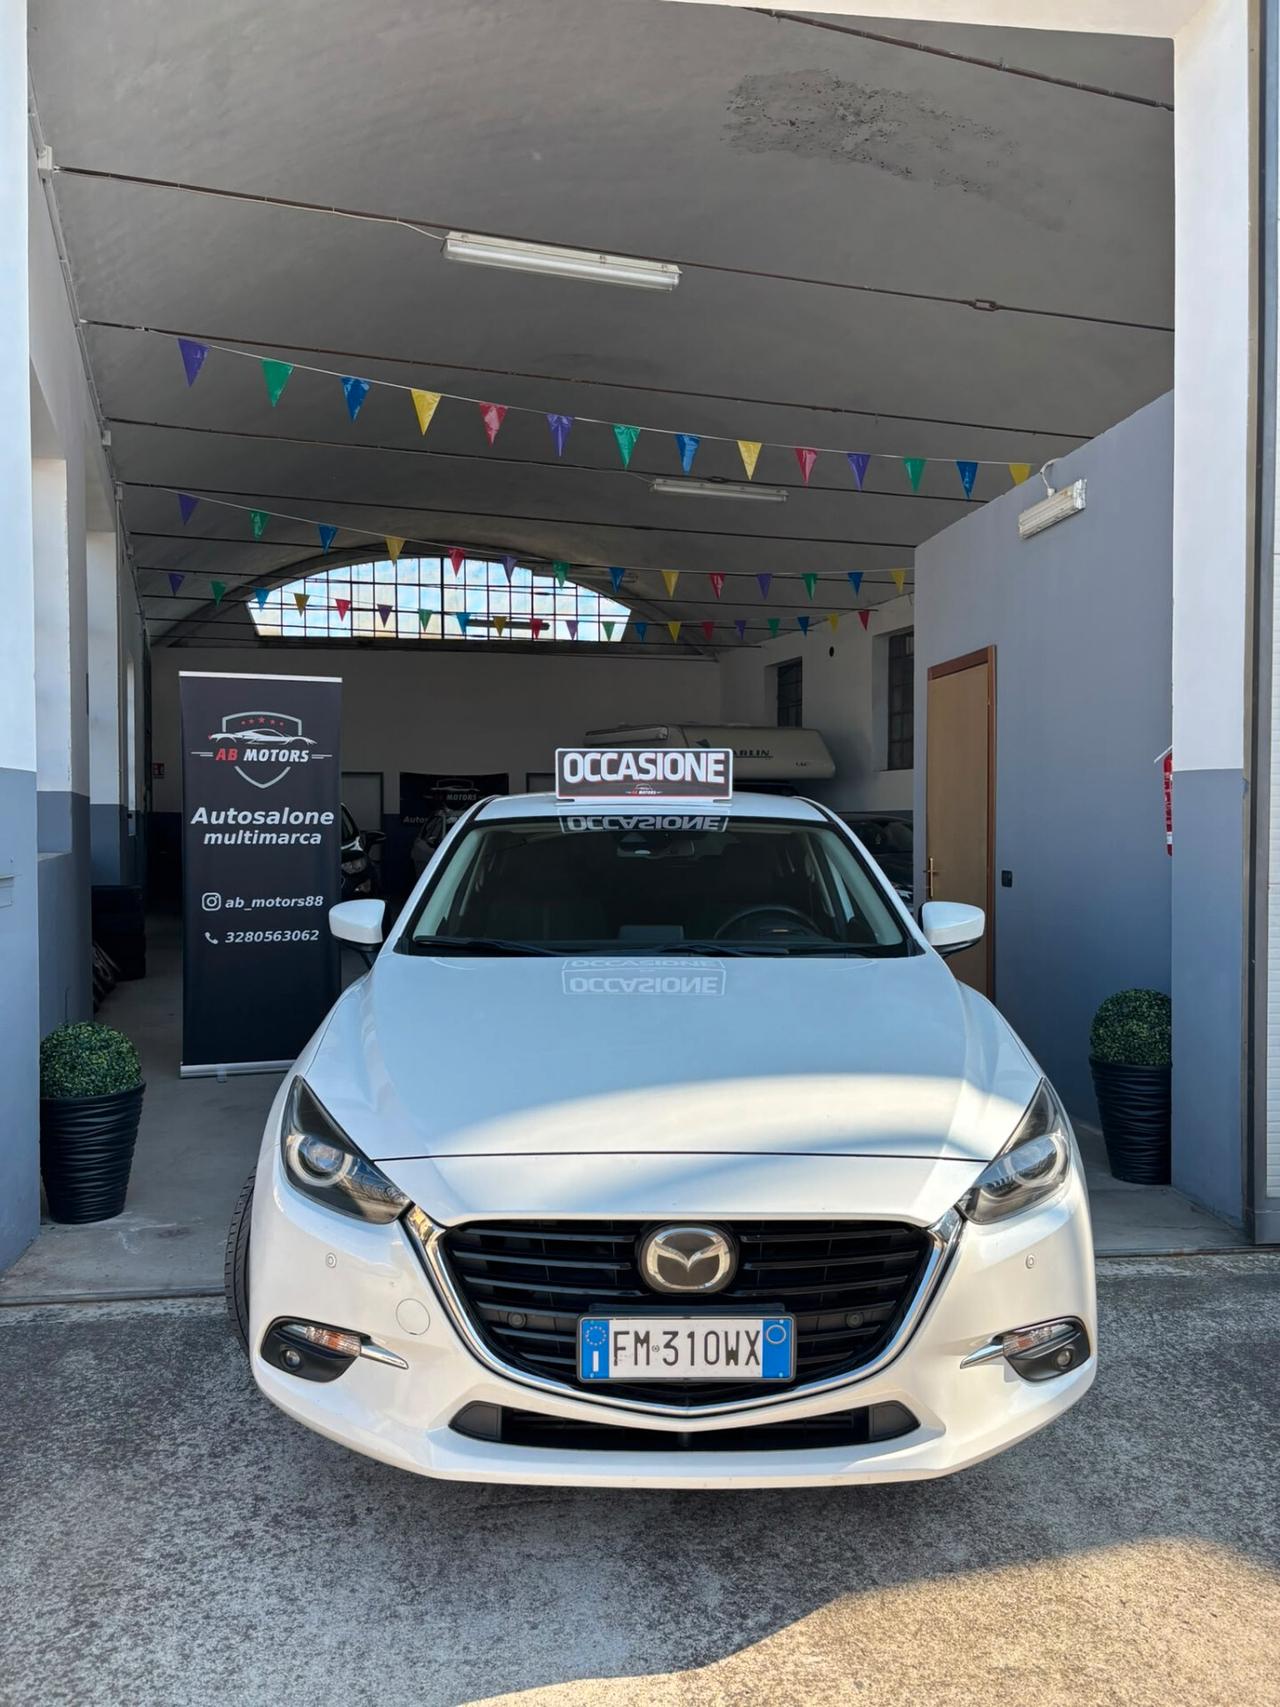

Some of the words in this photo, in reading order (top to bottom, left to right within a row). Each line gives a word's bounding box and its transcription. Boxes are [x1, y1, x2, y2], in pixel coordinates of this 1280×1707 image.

[215, 748, 238, 761] AB
[243, 748, 310, 762] MOTORS
[563, 752, 725, 784] OCCASIONE
[190, 807, 335, 825] Autosalone
[203, 830, 322, 845] multimarca
[225, 896, 324, 911] ab_motors88
[225, 930, 320, 943] 3280563062
